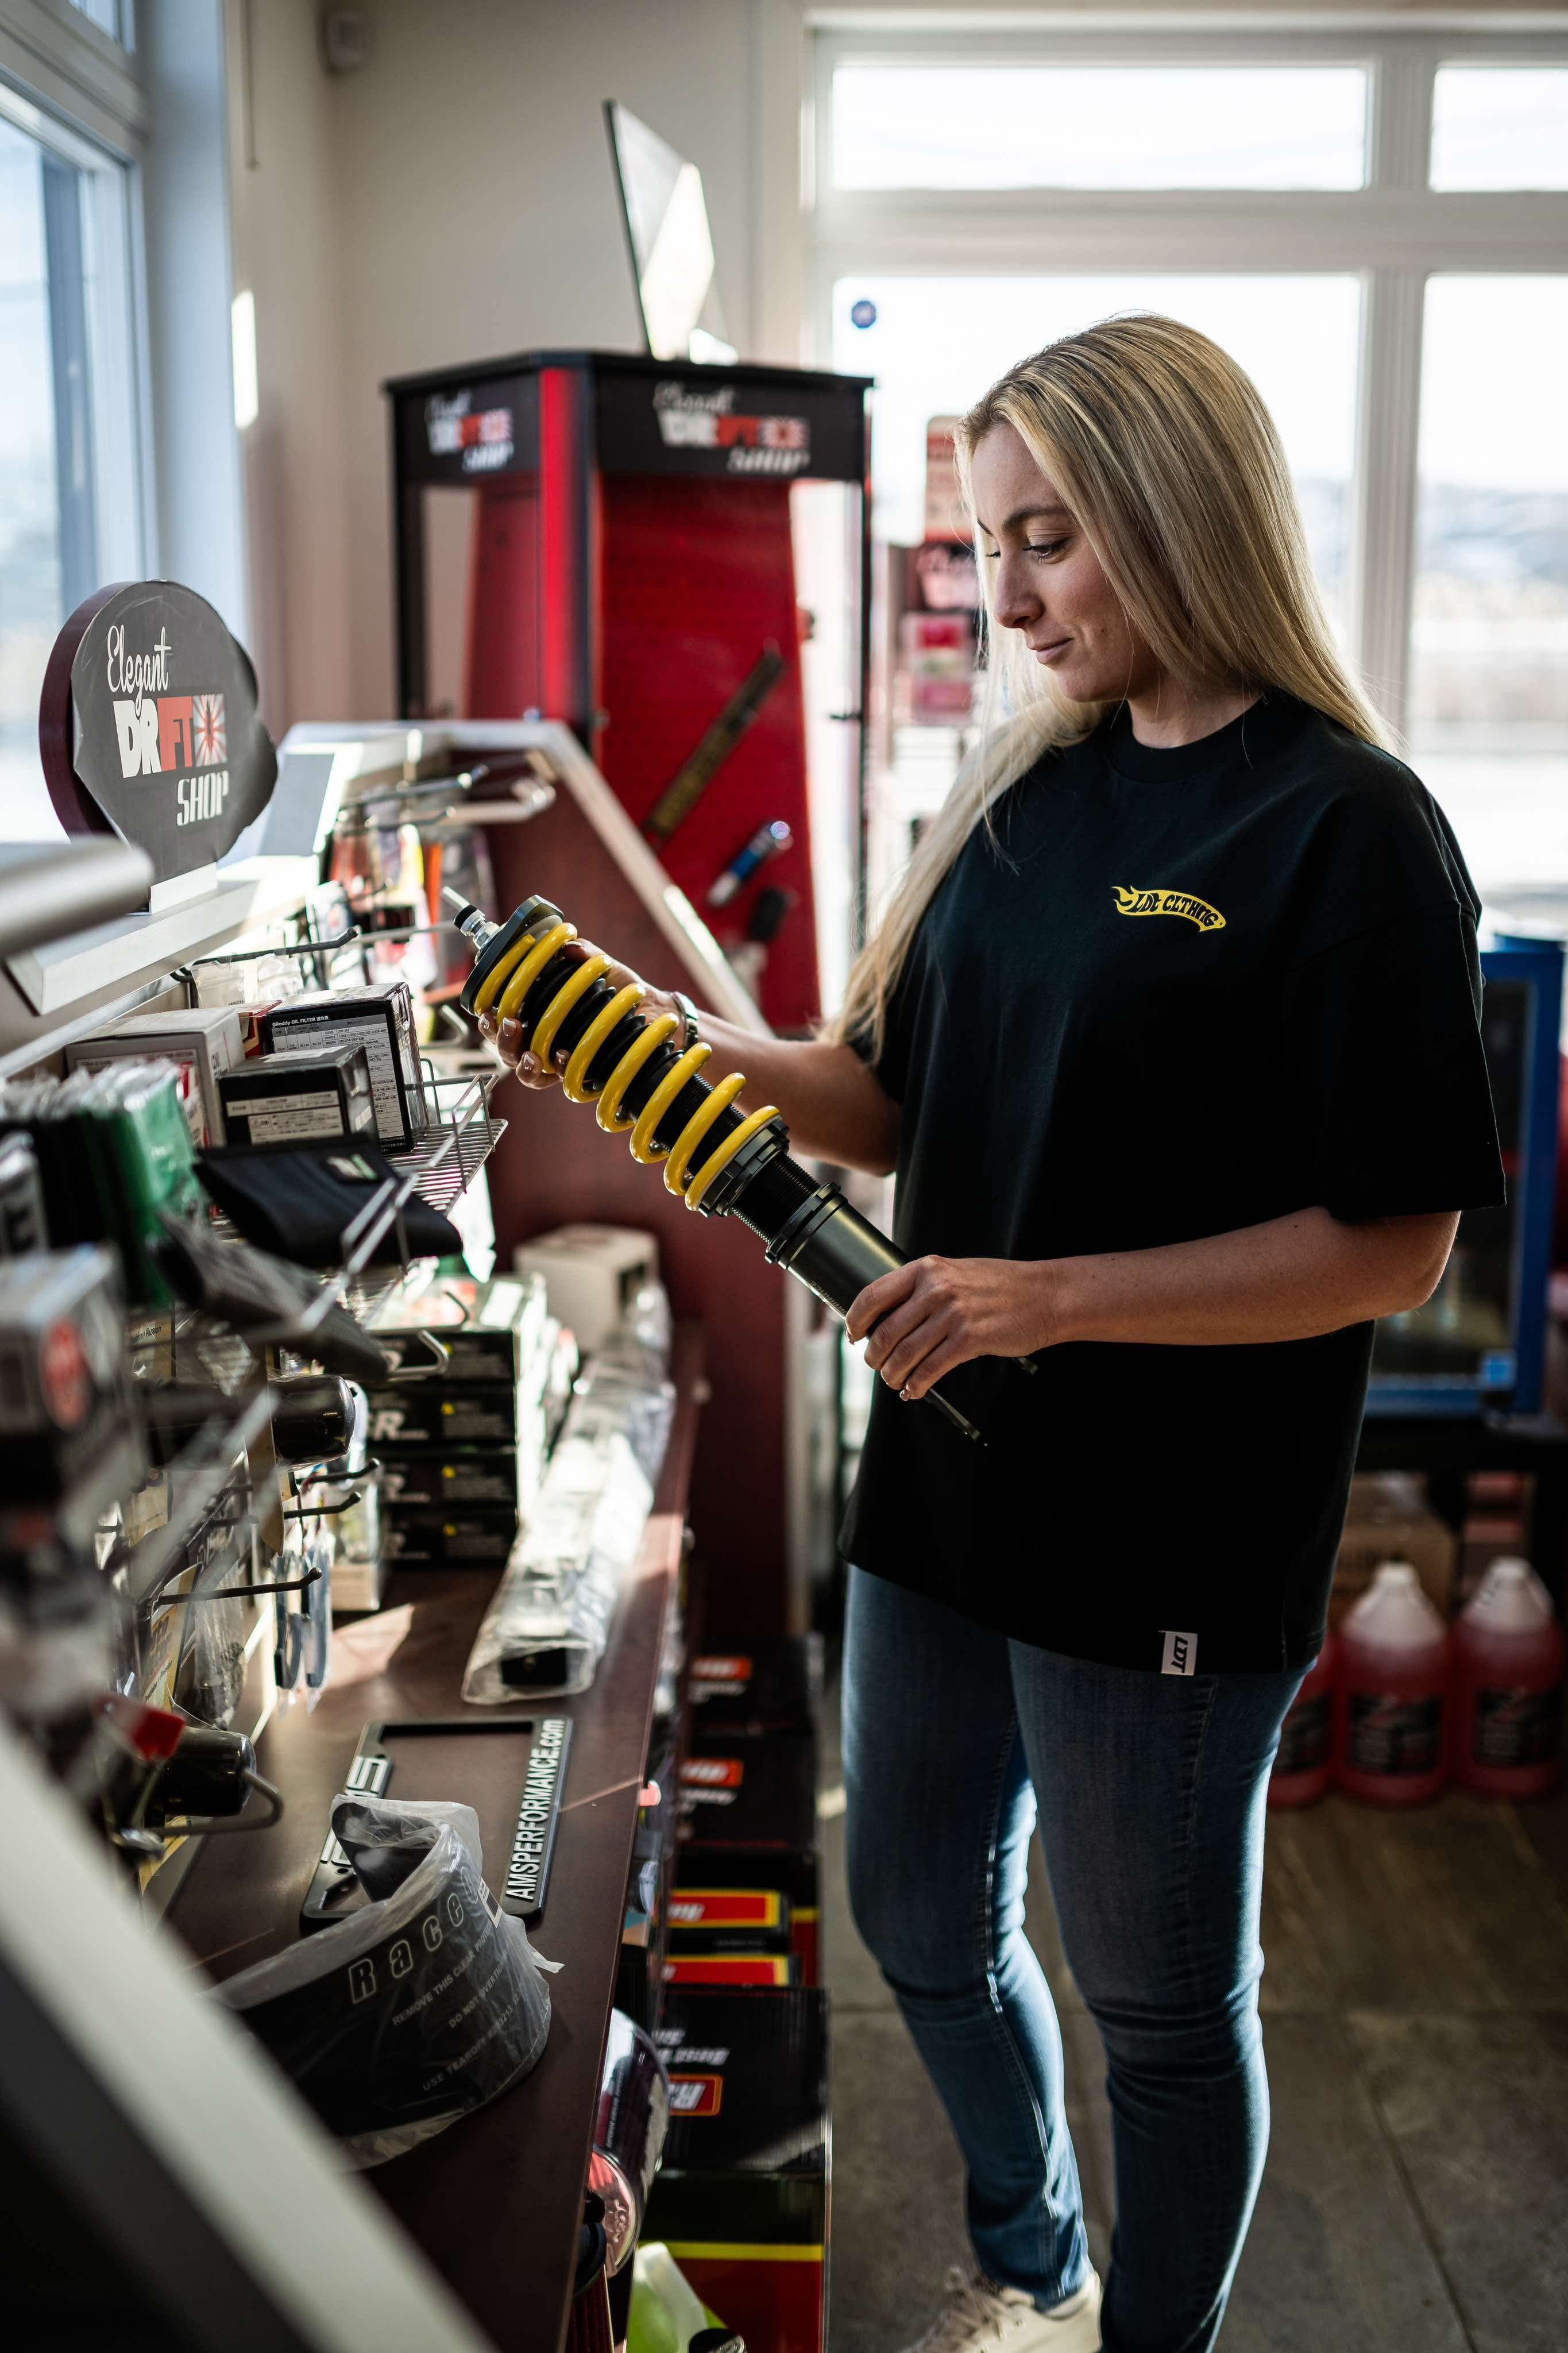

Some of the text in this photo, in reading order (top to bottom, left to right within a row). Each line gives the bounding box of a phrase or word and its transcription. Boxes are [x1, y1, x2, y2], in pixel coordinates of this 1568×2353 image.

[107, 624, 172, 716] Elegant
[177, 770, 229, 827] SHOP
[505, 1718, 565, 1901] AMSPERFORMANCE.com
[392, 1991, 434, 2026] REMOVE
[432, 1974, 454, 1995] THIS
[453, 1950, 476, 1977] CLEAR
[448, 2012, 463, 2028] DO
[462, 1995, 479, 2015] NOT
